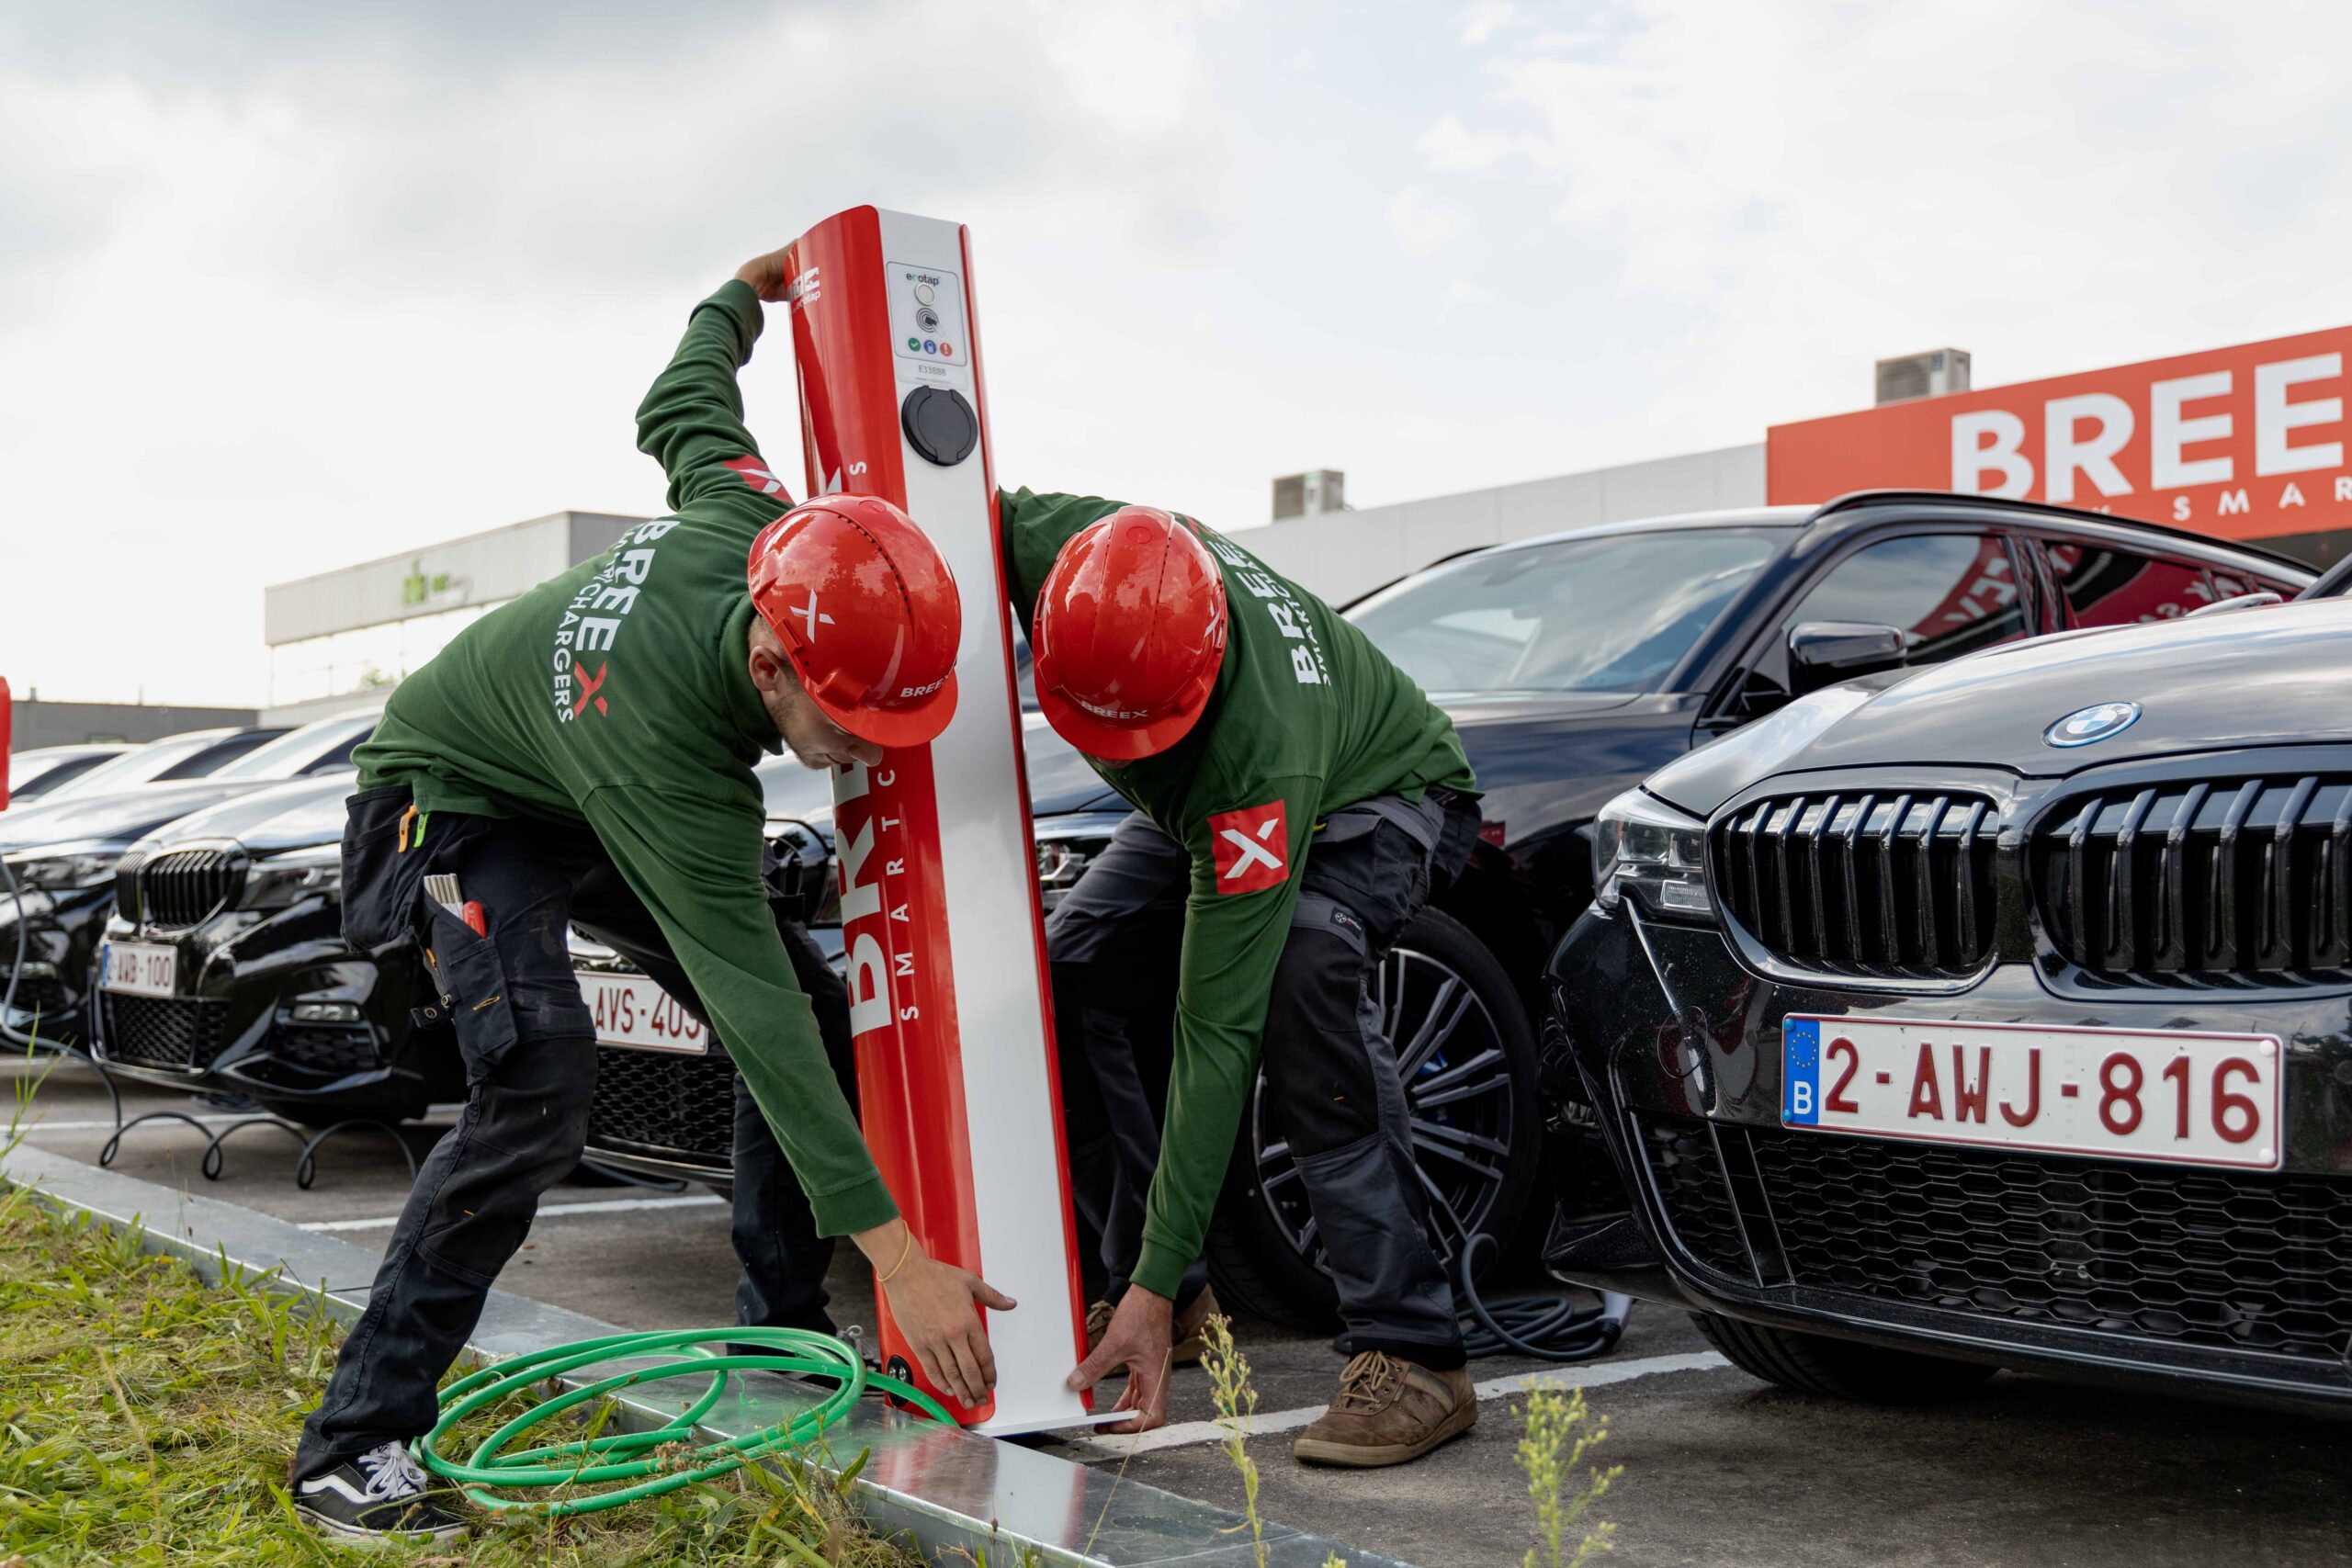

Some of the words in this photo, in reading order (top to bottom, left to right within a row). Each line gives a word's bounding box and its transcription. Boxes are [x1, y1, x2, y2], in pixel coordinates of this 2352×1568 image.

[1951, 352, 2344, 503] BREE
[553, 582, 602, 724] CHARGERS
[573, 519, 681, 719] BREEX
[1080, 700, 1148, 719] BREEX
[1793, 1080, 1812, 1115] B
[1825, 1035, 2261, 1145] 2-AWJ-816
